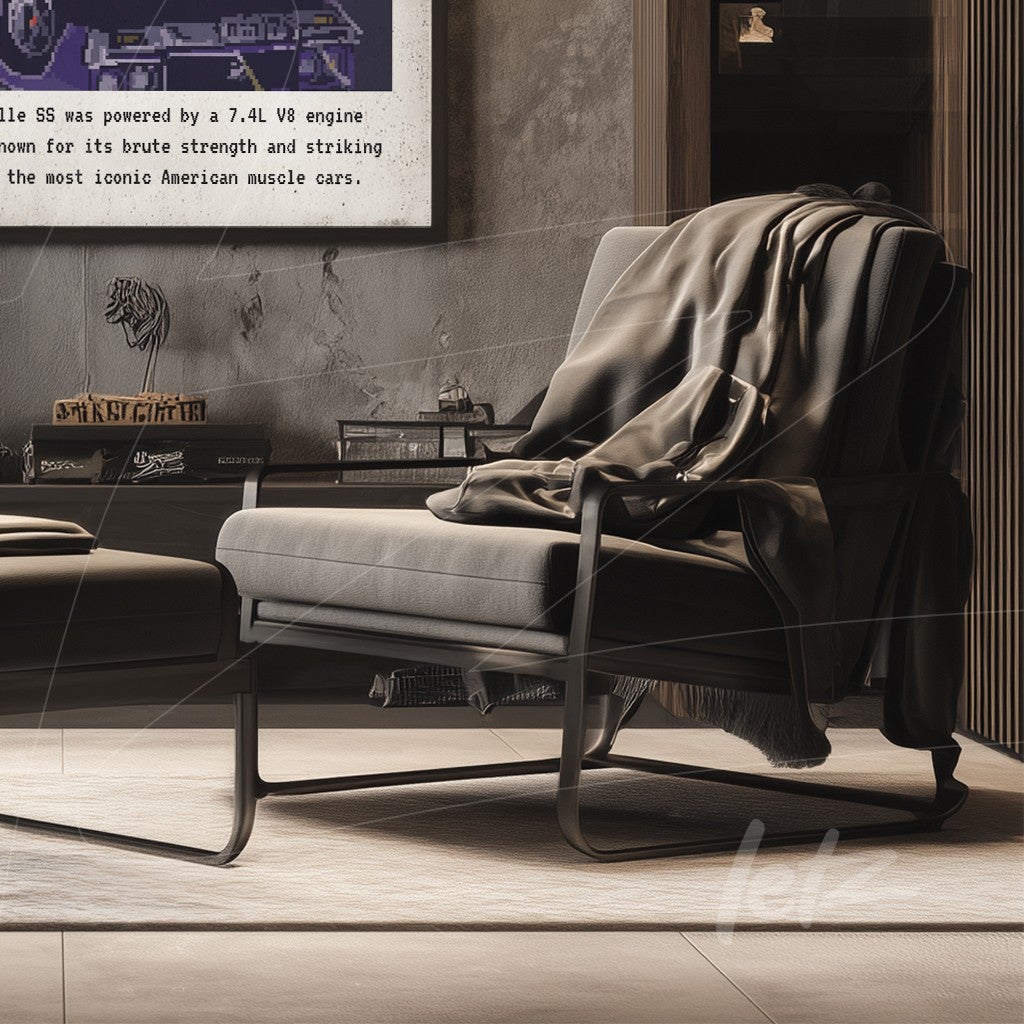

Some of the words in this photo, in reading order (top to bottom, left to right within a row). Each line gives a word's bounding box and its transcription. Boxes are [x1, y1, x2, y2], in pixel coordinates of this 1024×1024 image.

[36, 107, 55, 123] SS
[65, 111, 93, 123] was
[103, 107, 171, 127] powered
[180, 107, 200, 127] by
[209, 111, 219, 123] a
[229, 107, 267, 123] 7.4L
[276, 107, 295, 123] V8
[305, 107, 363, 127] engine
[46, 138, 74, 154] for
[85, 138, 113, 154] its
[122, 138, 171, 154] brute
[180, 138, 257, 158] strength
[267, 138, 296, 154] and
[306, 138, 382, 158] striking
[7, 168, 36, 185] the
[45, 169, 83, 185] most
[94, 169, 152, 185] iconic
[161, 169, 238, 185] American
[247, 169, 306, 185] muscle
[315, 173, 362, 185] cars.
